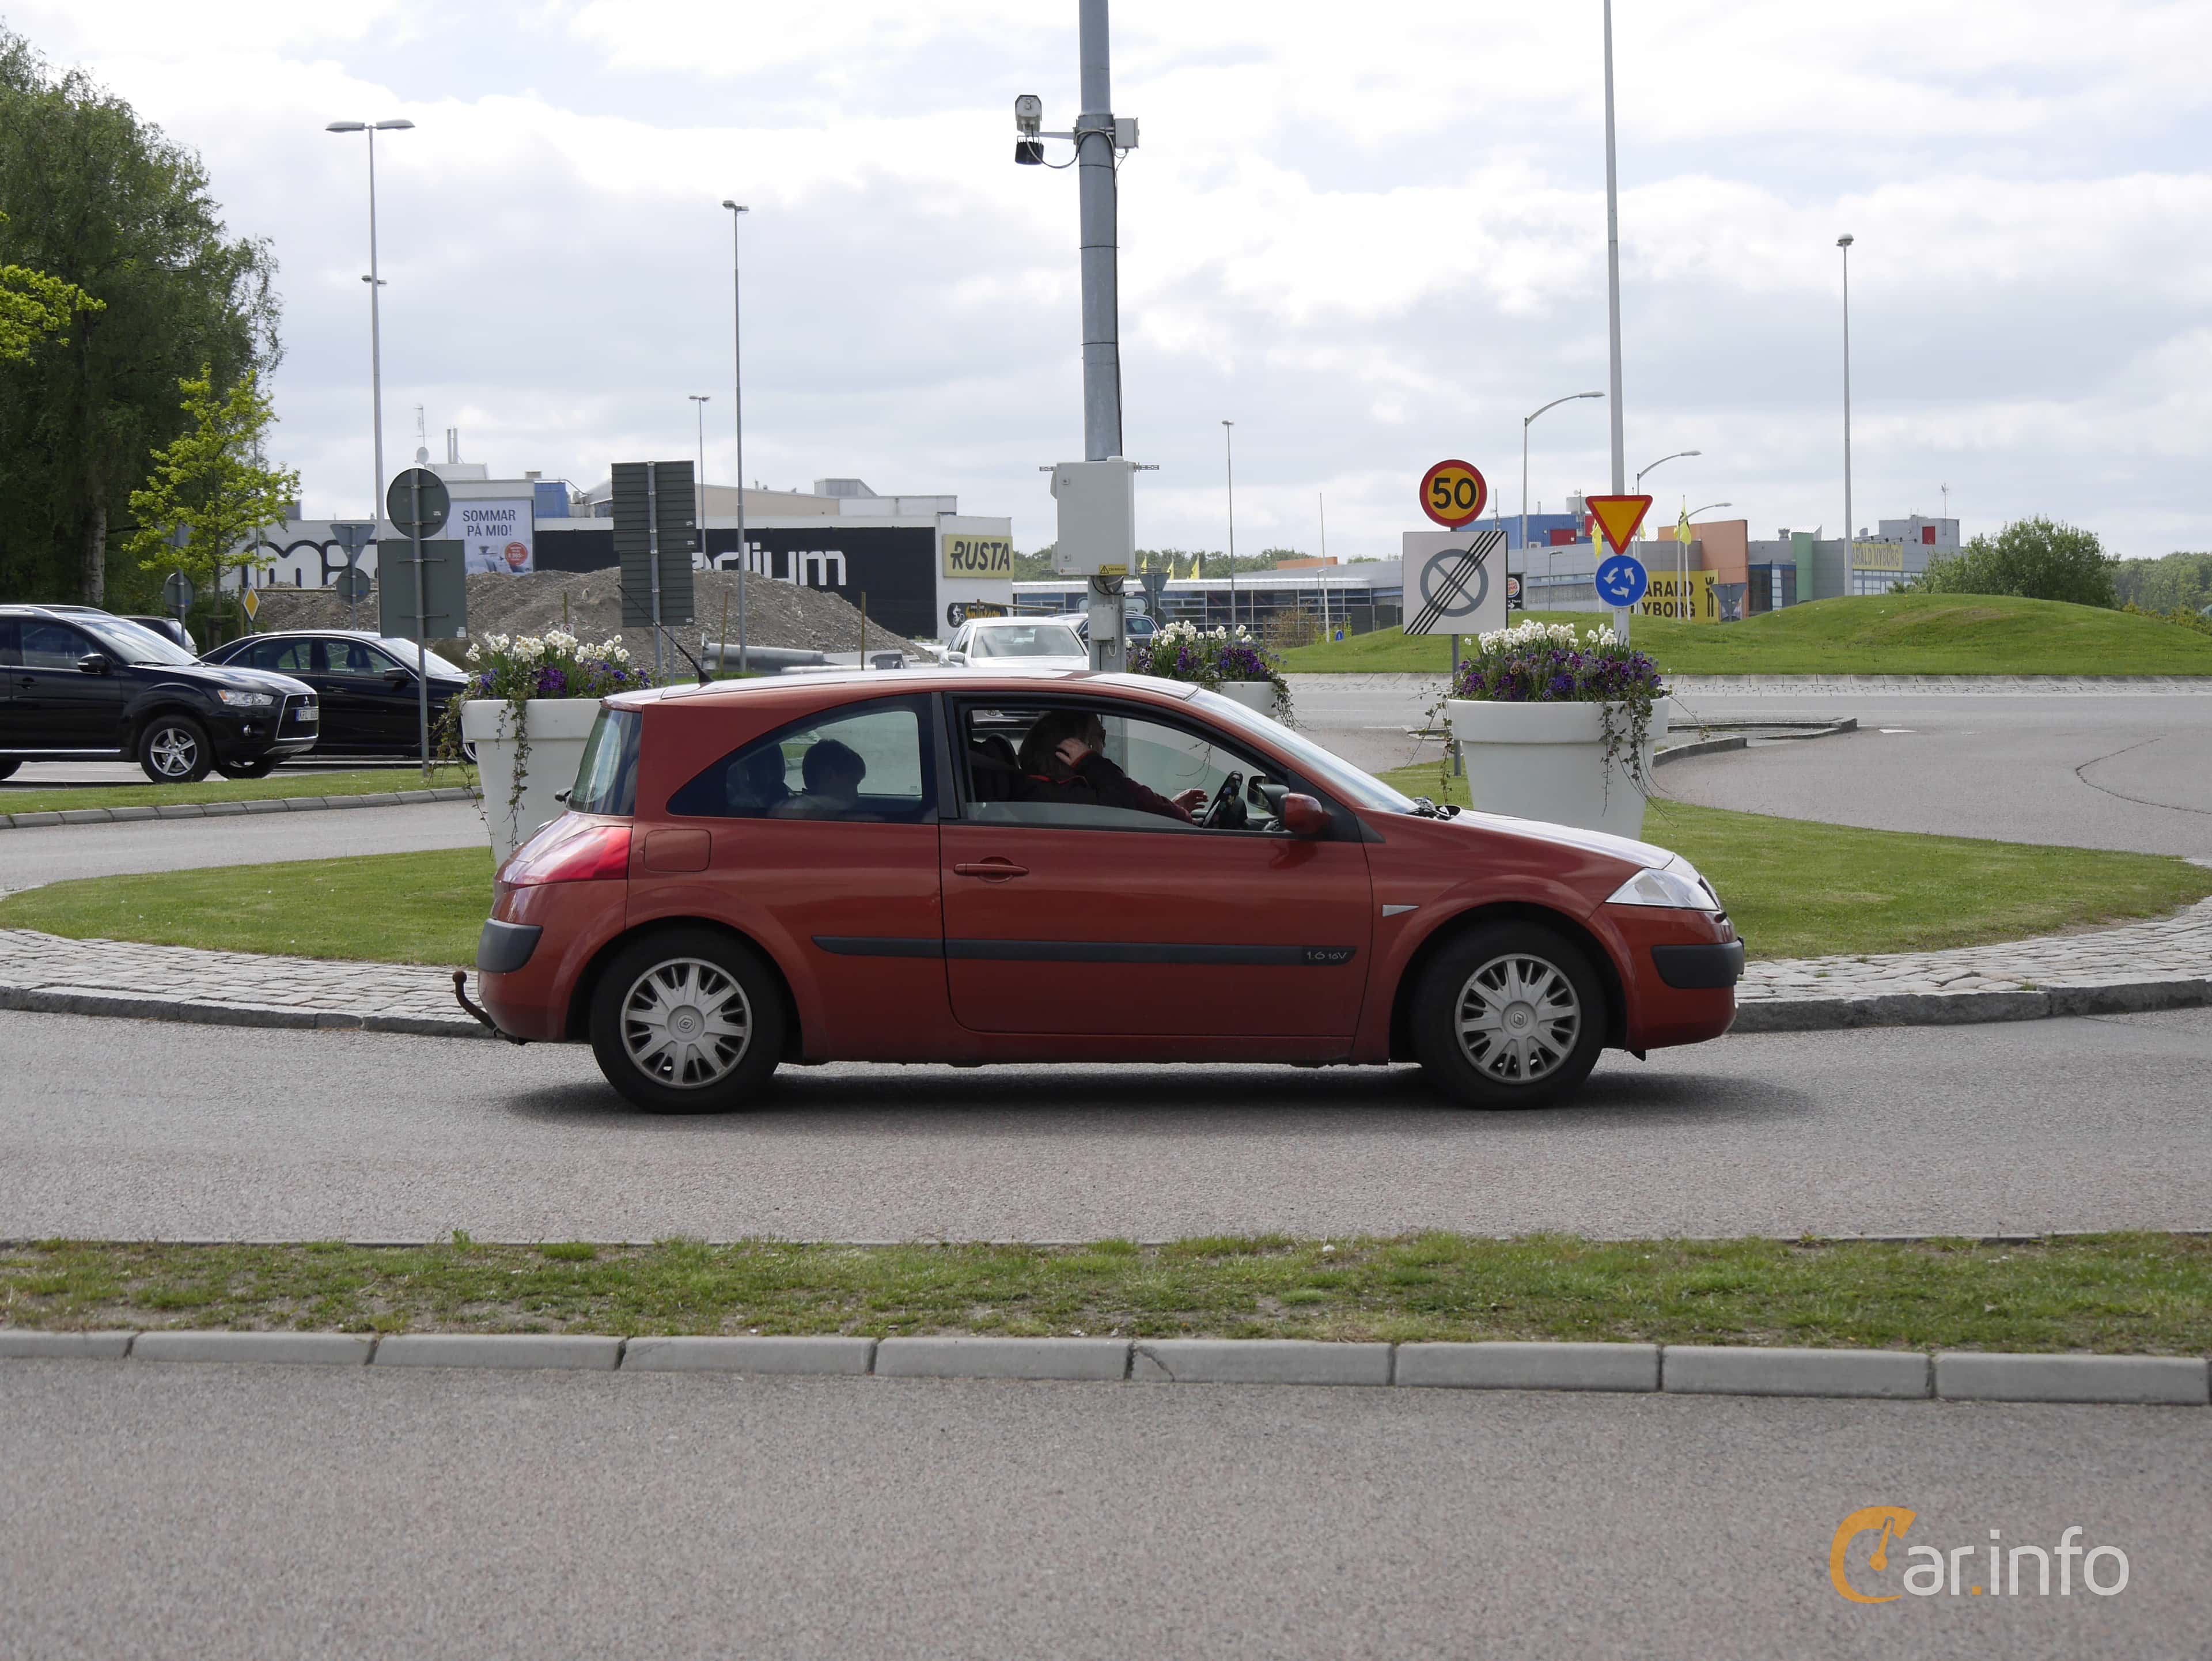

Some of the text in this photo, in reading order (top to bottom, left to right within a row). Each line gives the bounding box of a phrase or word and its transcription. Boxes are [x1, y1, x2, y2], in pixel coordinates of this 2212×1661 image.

[1433, 478, 1476, 509] 50
[463, 509, 516, 521] SOMMAR
[467, 523, 512, 536] PÅ MIO!
[950, 540, 1010, 571] RUSTA
[1643, 580, 1694, 597] ARALD
[1631, 601, 1696, 618] YBORG
